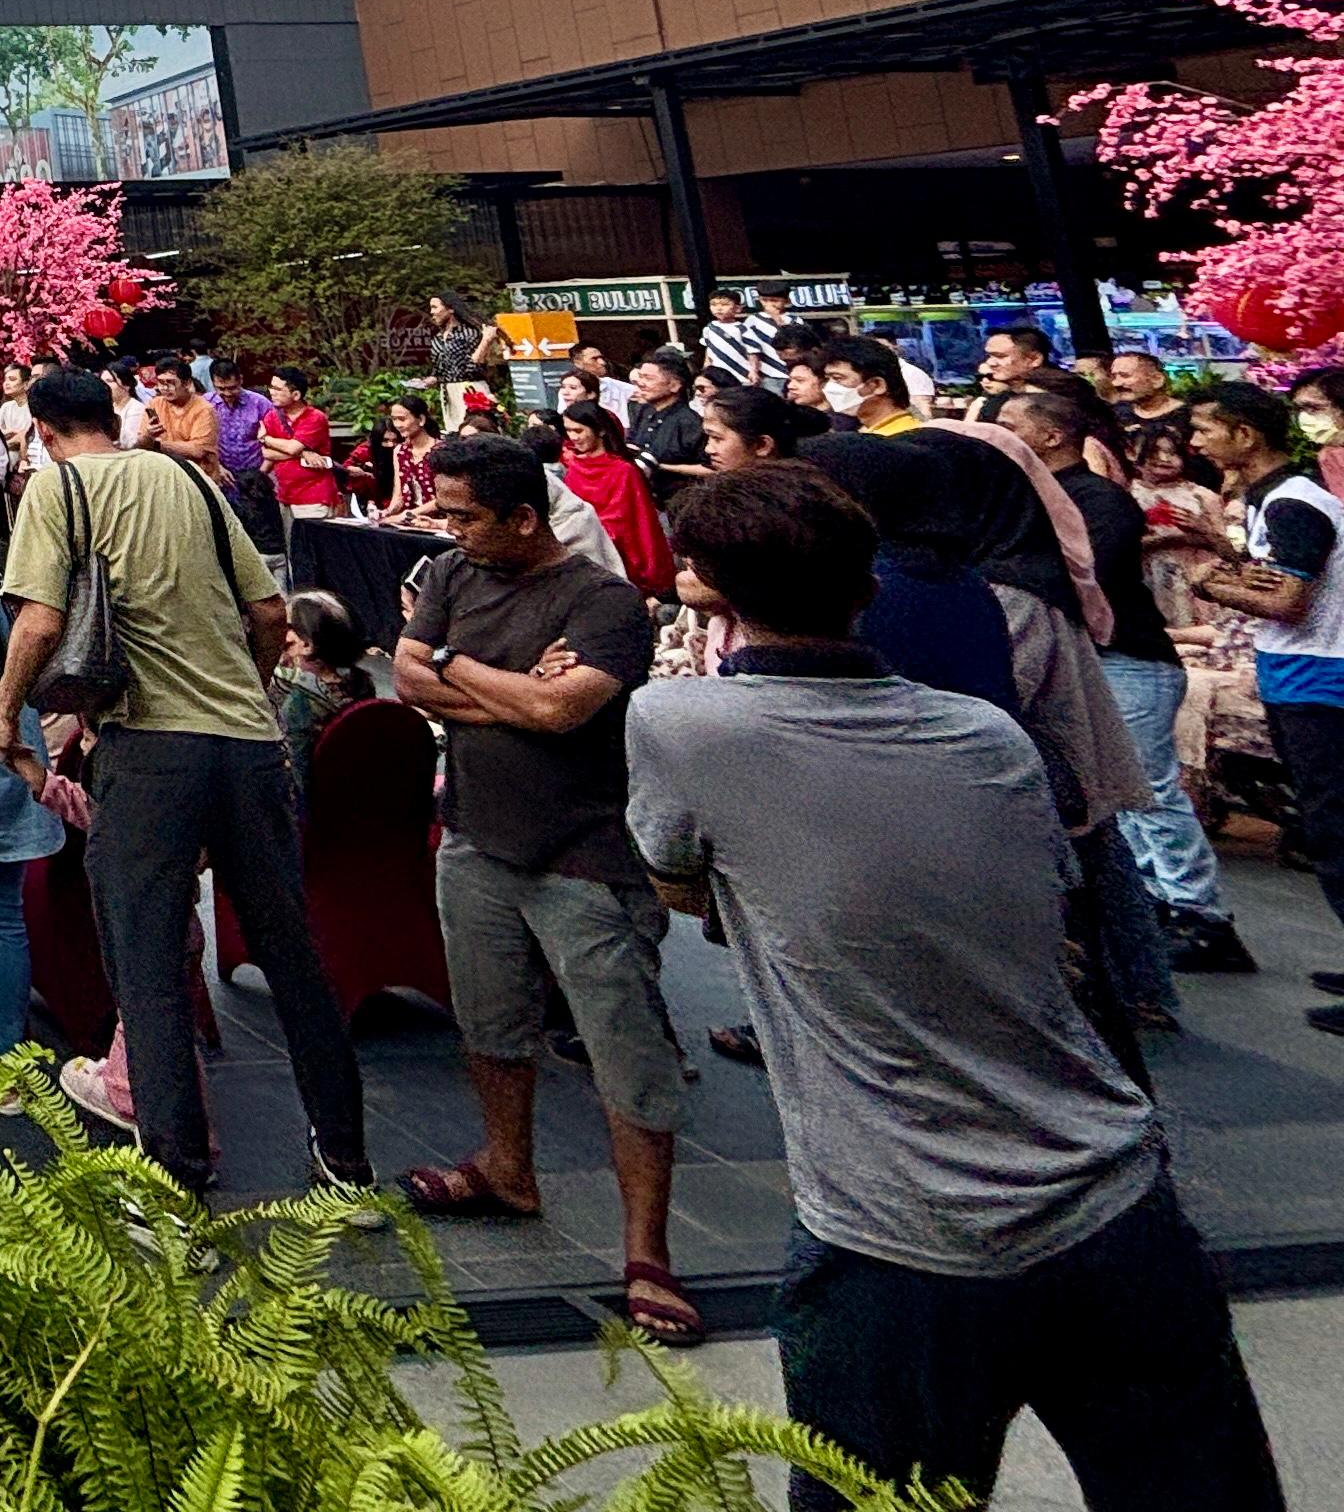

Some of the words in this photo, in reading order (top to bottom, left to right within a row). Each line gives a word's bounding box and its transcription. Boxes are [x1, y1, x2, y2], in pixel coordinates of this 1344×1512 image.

[532, 291, 582, 312] KOPI
[588, 289, 661, 312] BULUH
[787, 284, 850, 308] ULUH
